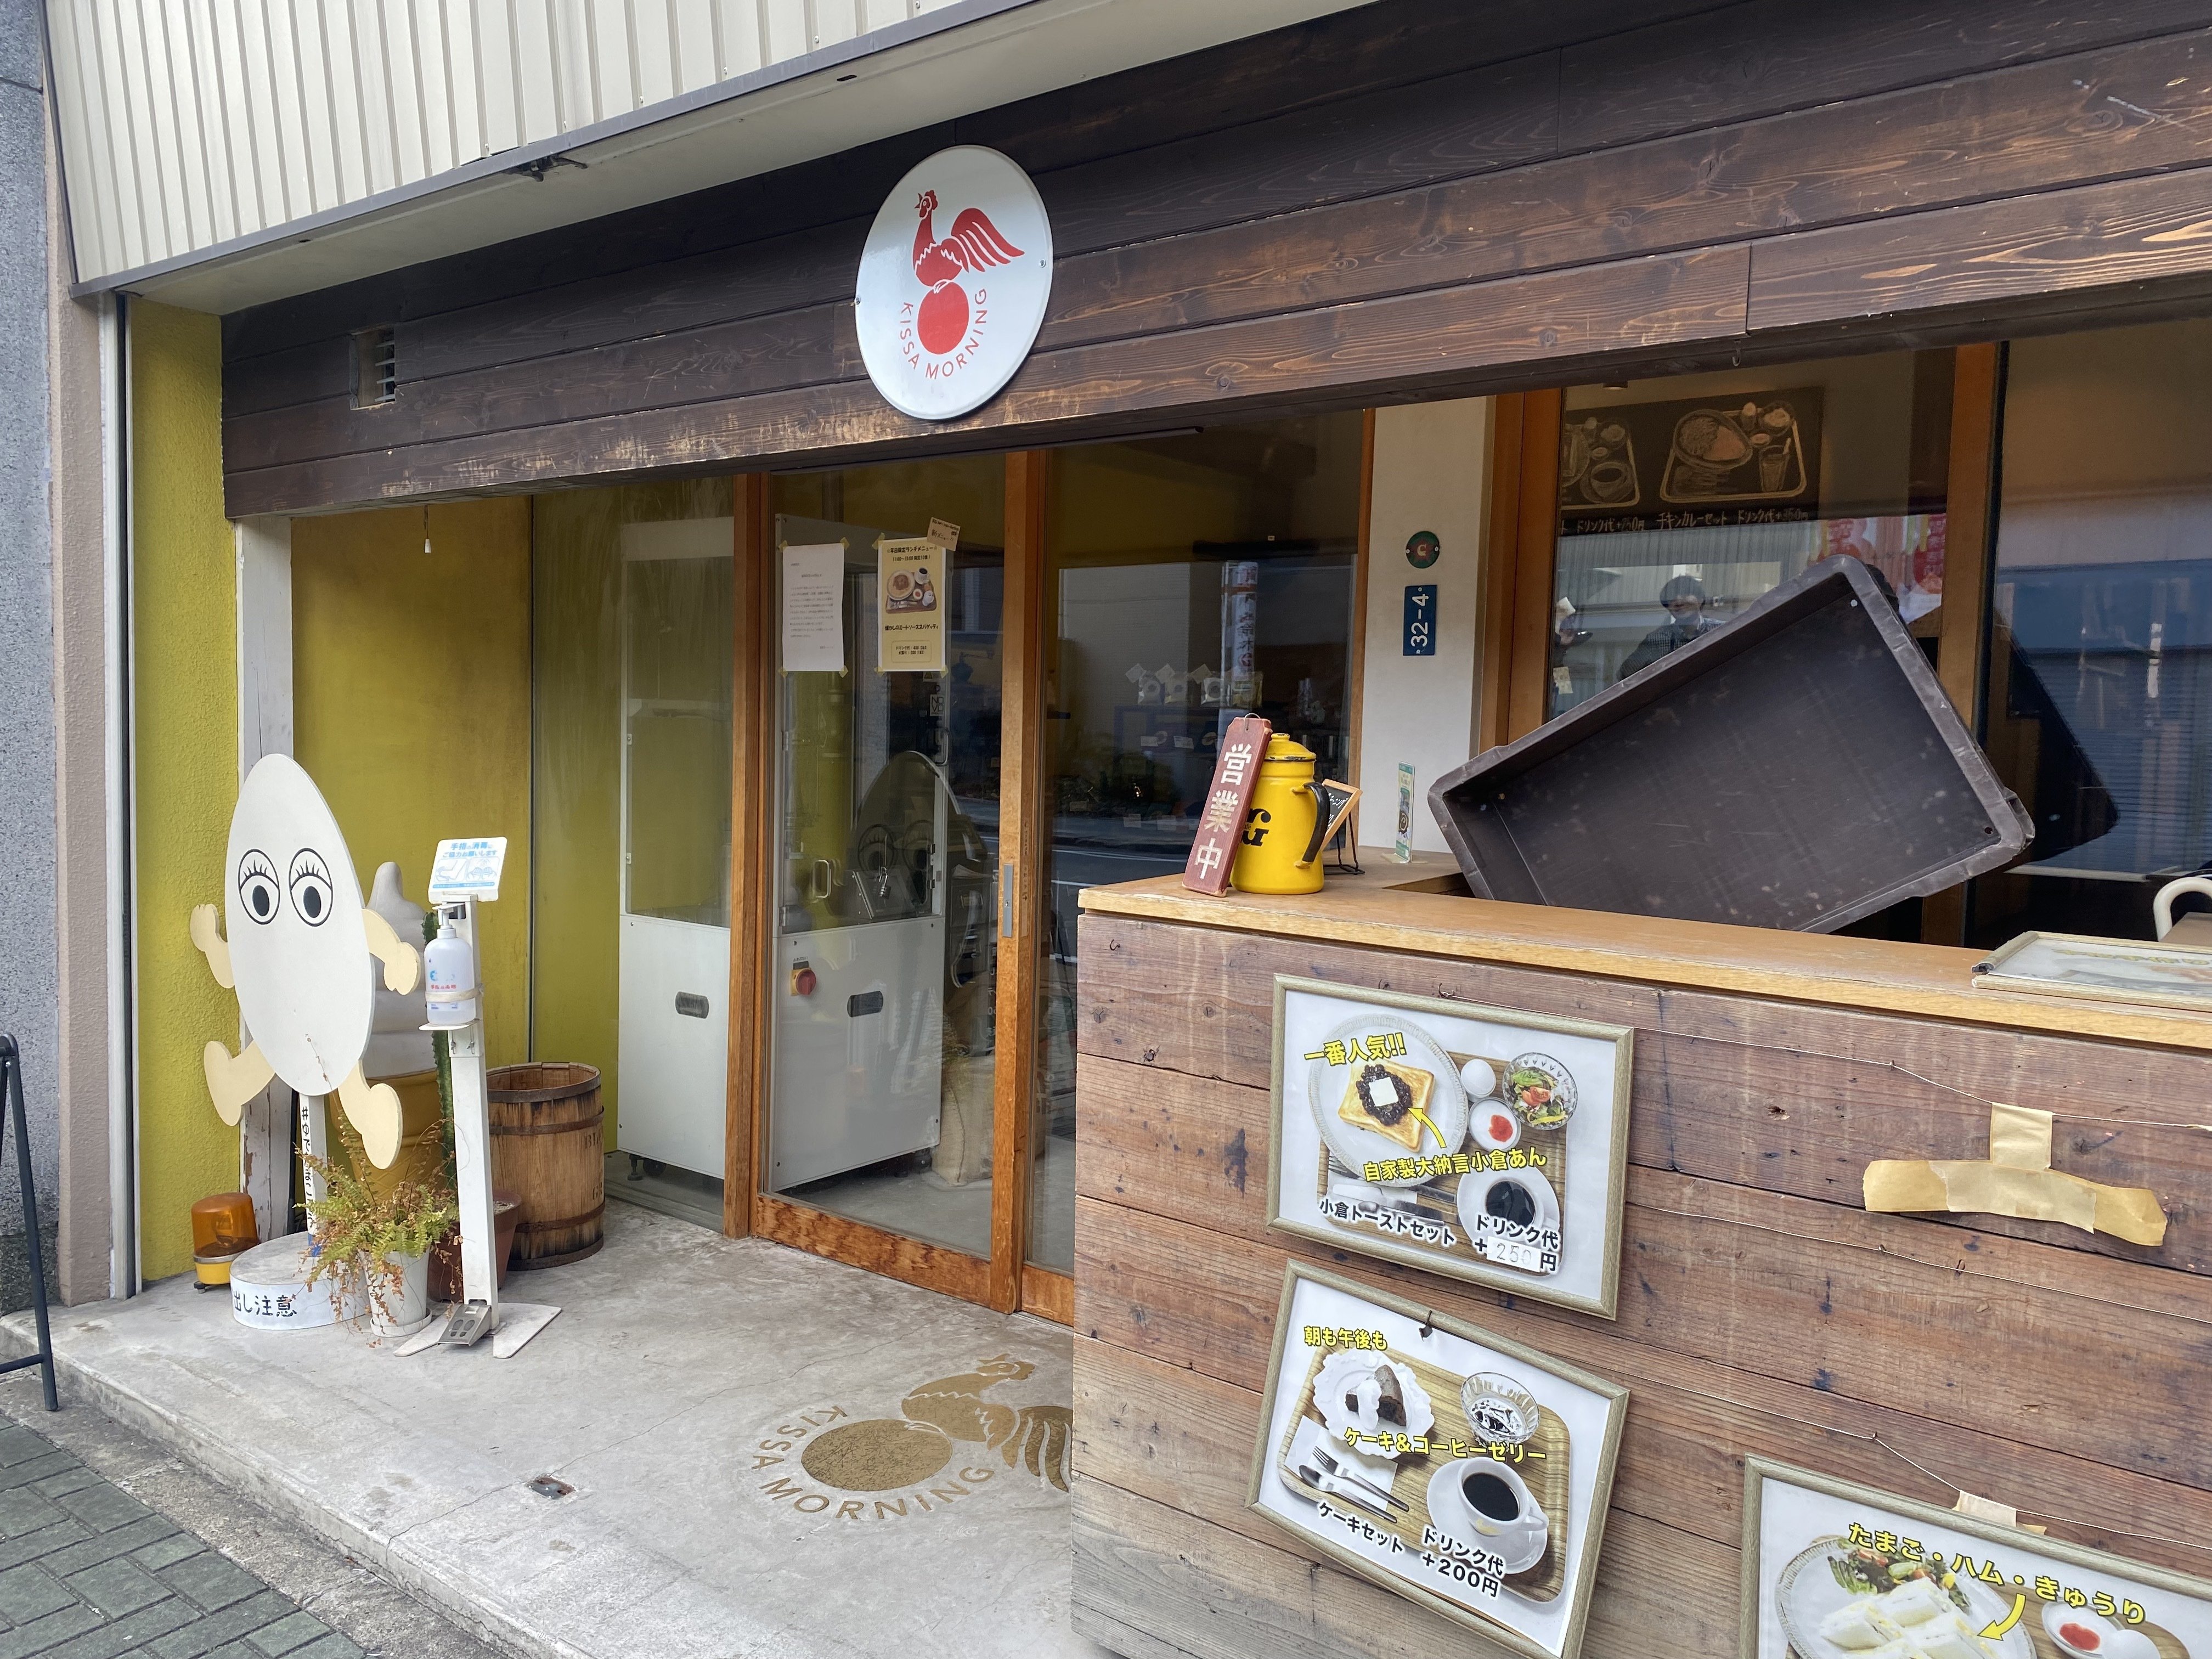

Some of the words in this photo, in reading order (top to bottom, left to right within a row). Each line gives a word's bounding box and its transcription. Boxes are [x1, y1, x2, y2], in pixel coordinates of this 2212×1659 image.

[900, 302, 921, 370] KISSA
[925, 288, 986, 379] MORNING
[1656, 511, 1728, 531] チキンカレーセット
[1410, 594, 1429, 647] 32-4
[1194, 743, 1252, 879] 営業中
[1304, 1032, 1406, 1066] 一番人気!!
[1363, 1146, 1547, 1183] 自家製大納言小倉あん
[1319, 1197, 1456, 1246] 小倉トーストセット
[1475, 1214, 1559, 1251] ドリンク代
[233, 1290, 297, 1317] 出し注意
[1304, 1325, 1388, 1350] 朝も午後も
[752, 1406, 848, 1470] KISSA
[1344, 1427, 1547, 1463] ケーキ&コーヒーゼリー
[759, 1465, 995, 1520] MORNING
[1318, 1502, 1404, 1554] ケーキセット
[1424, 1527, 1505, 1576] ドリンク代
[1422, 1555, 1499, 1598] +200円
[1848, 1522, 2146, 1624] たまご・ハム・きゅうり
